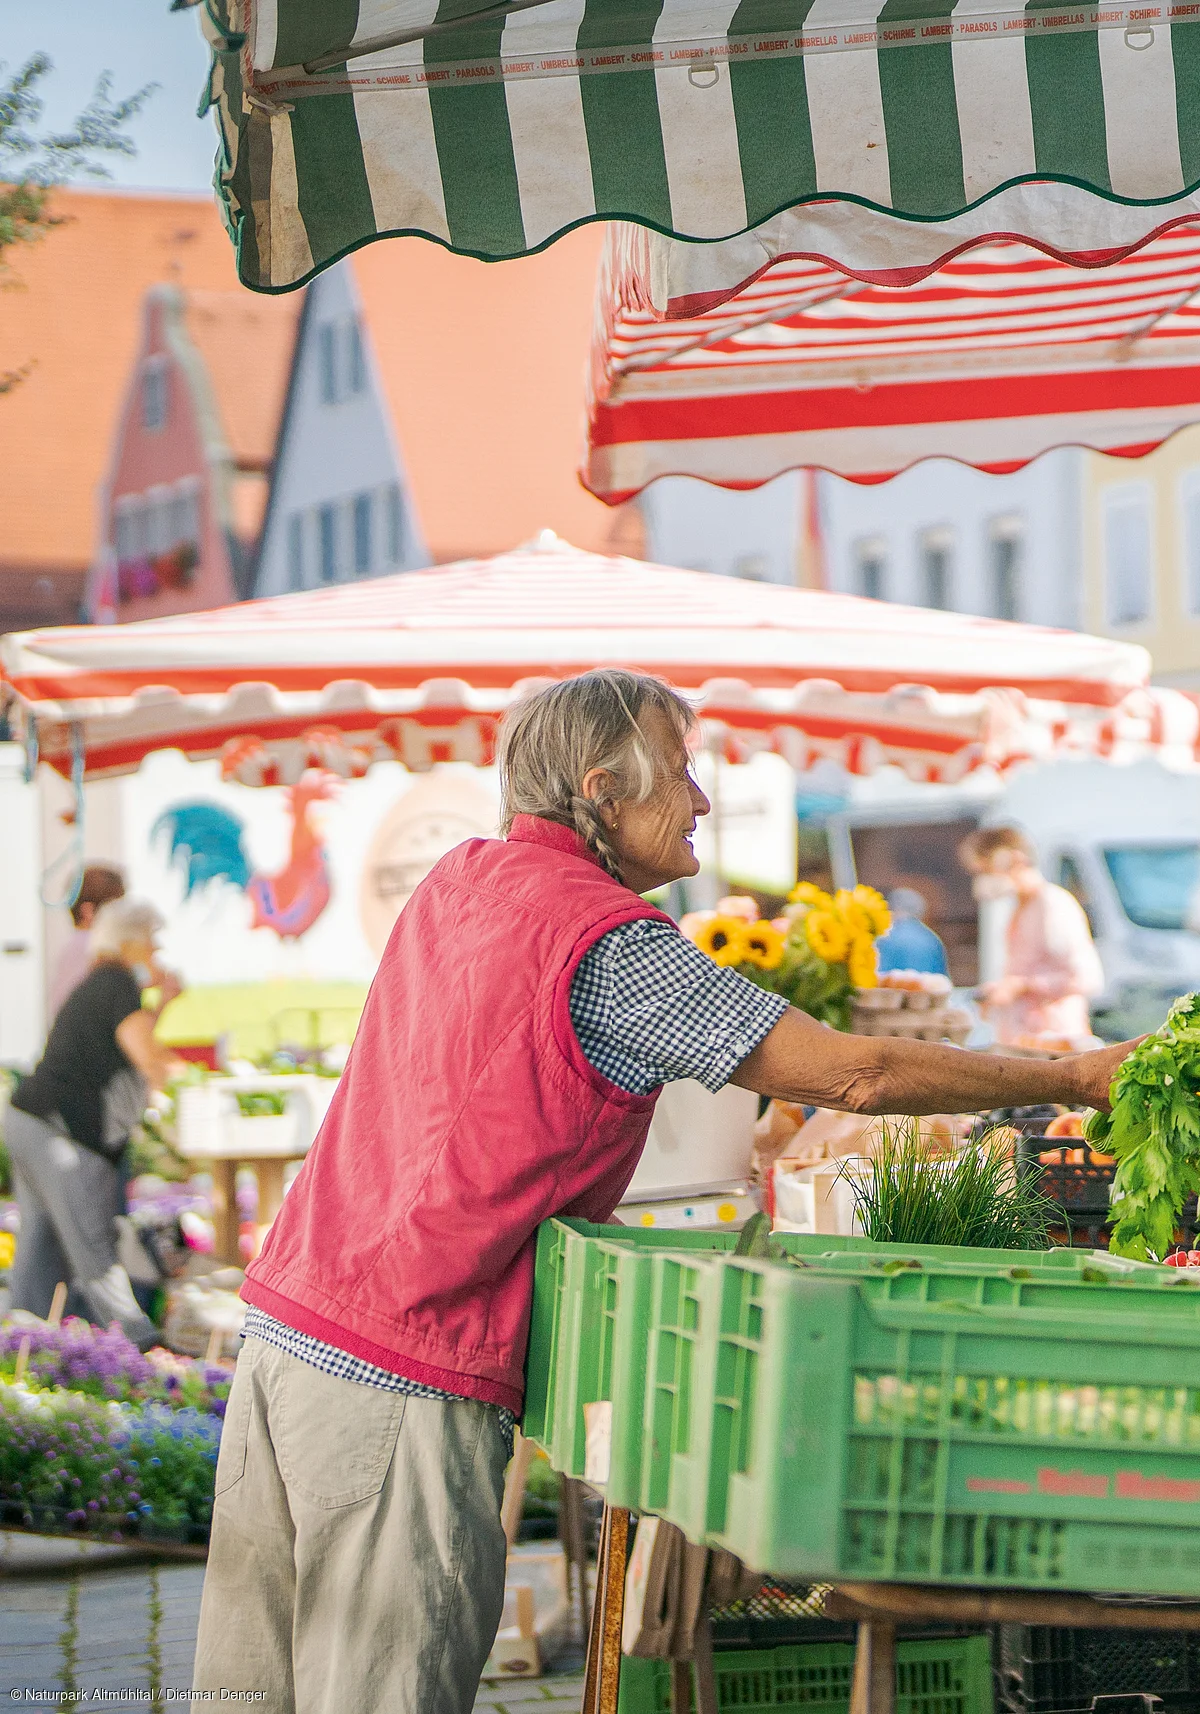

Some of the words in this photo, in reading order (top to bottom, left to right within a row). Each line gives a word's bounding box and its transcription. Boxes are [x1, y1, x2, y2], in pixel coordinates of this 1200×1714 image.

[376, 74, 411, 84] SCHIRME
[415, 70, 450, 82] LAMBERT
[456, 66, 495, 78] PARASOLS
[501, 62, 535, 74] LAMBERT
[541, 58, 585, 70] UMBRELLAS
[591, 55, 625, 66] LAMBERT
[631, 51, 665, 63] SCHIRME
[670, 48, 704, 60] LAMBERT
[710, 43, 748, 55] PARASOLS
[753, 40, 789, 52] LAMBERT
[795, 35, 837, 48] UMBRELLAS
[844, 32, 877, 44] LAMBERT
[883, 28, 916, 40] SCHIRME
[921, 24, 954, 37] LAMBERT
[960, 22, 997, 33] PARASOLS
[1003, 18, 1036, 30] LAMBERT
[1042, 14, 1084, 27] UMBRELLAS
[1090, 11, 1123, 22] LAMBERT
[1129, 8, 1161, 20] SCHIRME
[1167, 4, 1200, 16] LAMBERT
